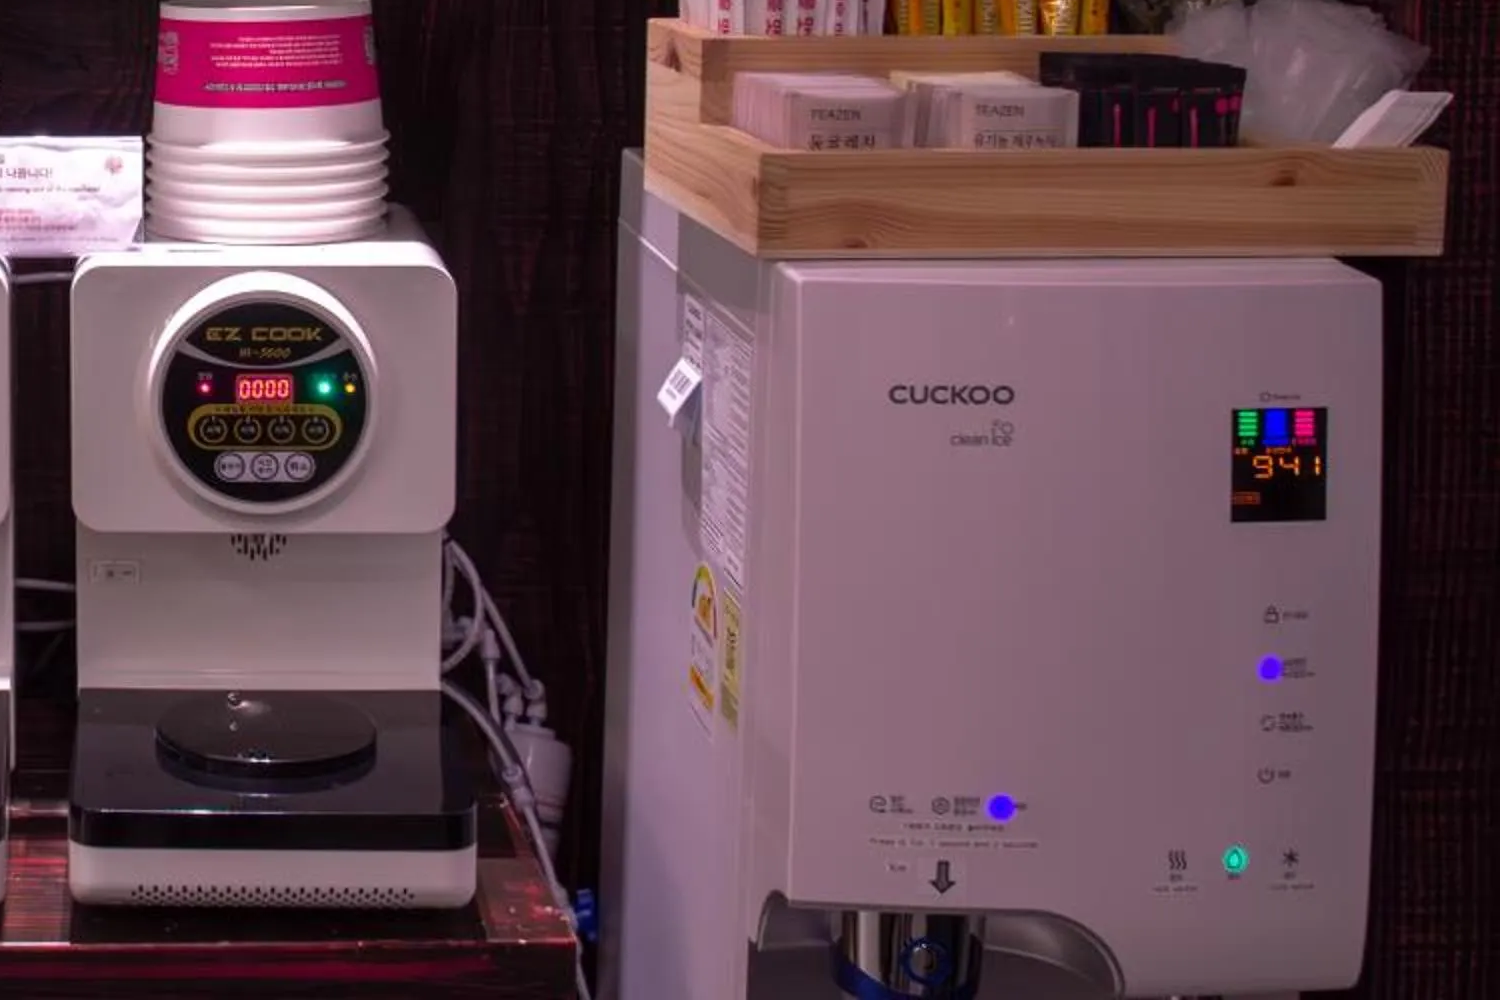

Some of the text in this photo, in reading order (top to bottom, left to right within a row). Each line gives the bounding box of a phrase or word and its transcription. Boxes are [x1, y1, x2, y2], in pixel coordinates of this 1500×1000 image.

[810, 108, 861, 121] TEAZEN
[975, 103, 1025, 118] TEAZEN
[206, 327, 323, 341] EZ COOK
[239, 379, 290, 400] 0000
[888, 384, 1015, 405] CUCKOO
